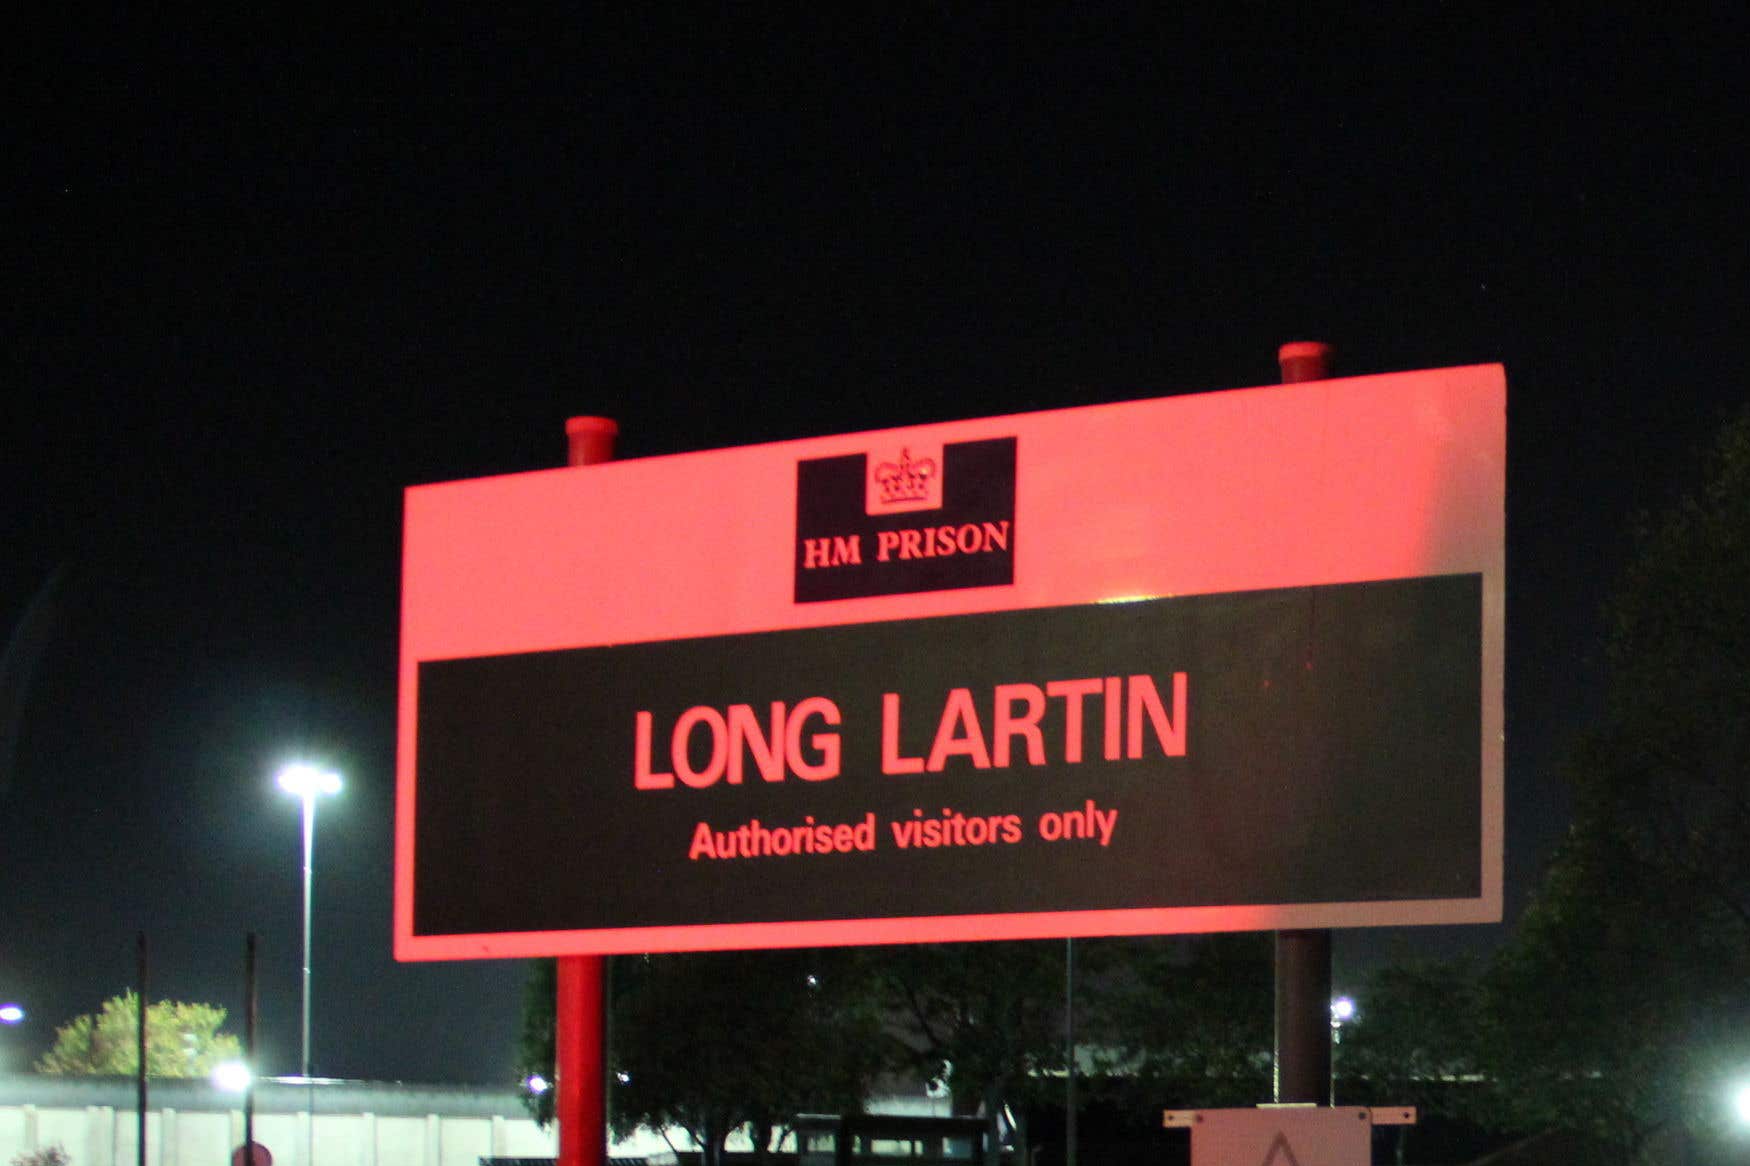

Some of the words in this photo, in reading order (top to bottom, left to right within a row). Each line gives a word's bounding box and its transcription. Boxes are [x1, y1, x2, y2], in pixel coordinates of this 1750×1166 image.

[803, 534, 862, 569] HM
[876, 520, 1009, 563] PRISON
[634, 696, 842, 790] LONG
[881, 672, 1188, 775] LARTIN
[688, 812, 876, 860] Authorised
[891, 808, 1022, 848] visitors
[1039, 800, 1118, 846] only
